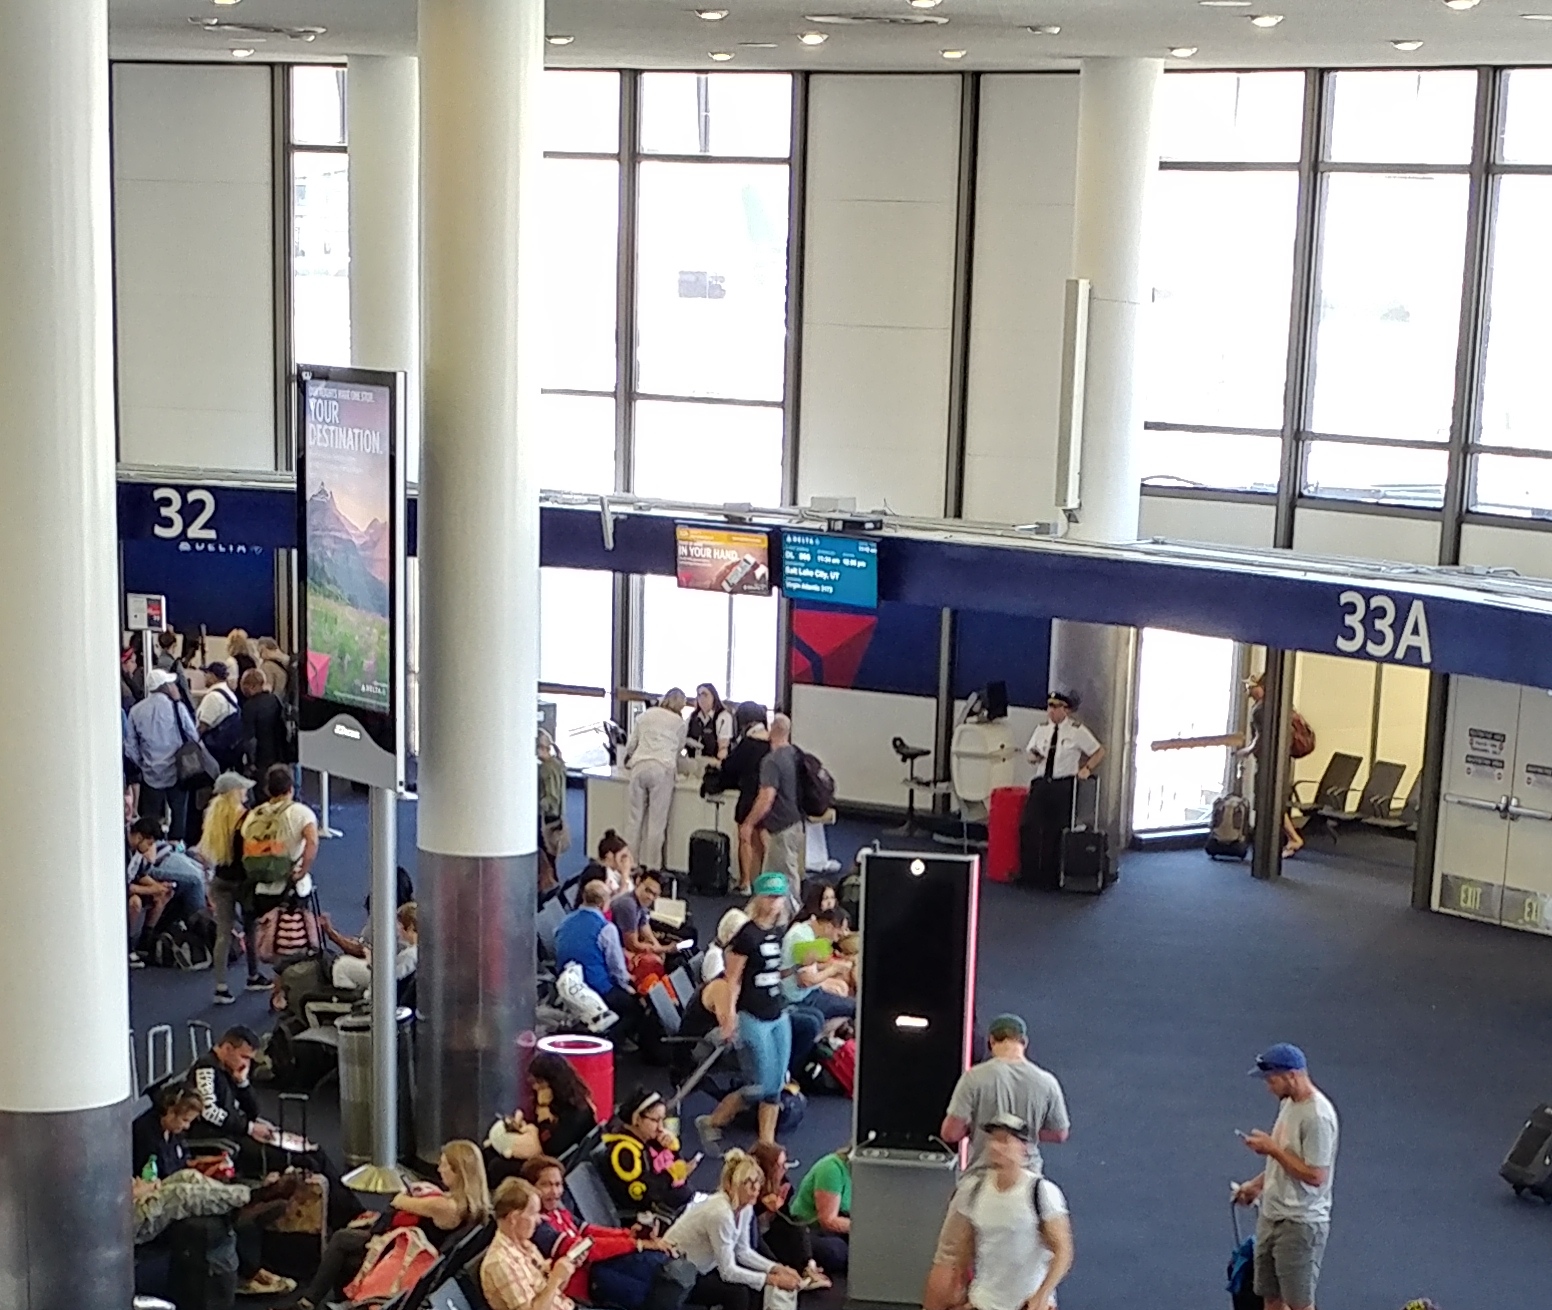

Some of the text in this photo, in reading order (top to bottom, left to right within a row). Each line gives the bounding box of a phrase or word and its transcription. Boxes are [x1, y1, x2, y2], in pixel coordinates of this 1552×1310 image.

[309, 397, 340, 424] YOUR
[308, 423, 384, 454] DESTINATION.
[153, 487, 217, 540] 32
[678, 545, 688, 556] IN
[689, 546, 712, 558] YOUR
[1336, 590, 1432, 664] 33A
[1459, 884, 1482, 911] EXIT
